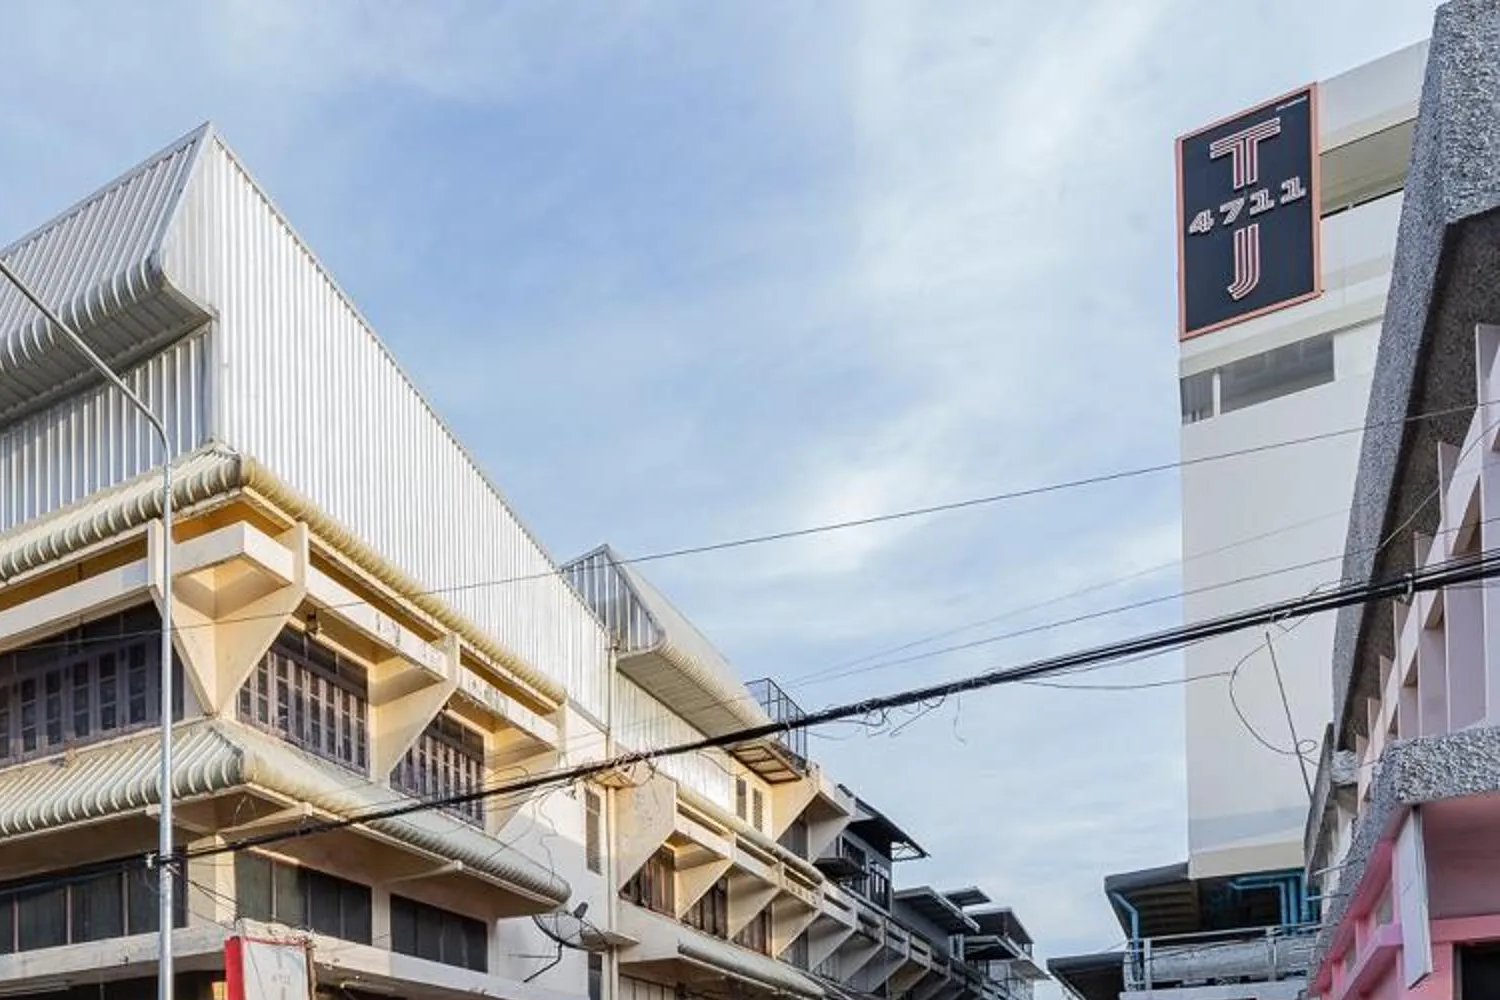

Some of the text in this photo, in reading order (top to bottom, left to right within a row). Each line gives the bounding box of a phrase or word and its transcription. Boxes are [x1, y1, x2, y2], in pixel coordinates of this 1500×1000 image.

[1209, 116, 1282, 190] T
[1188, 175, 1308, 234] 4711
[1227, 223, 1261, 300] J
